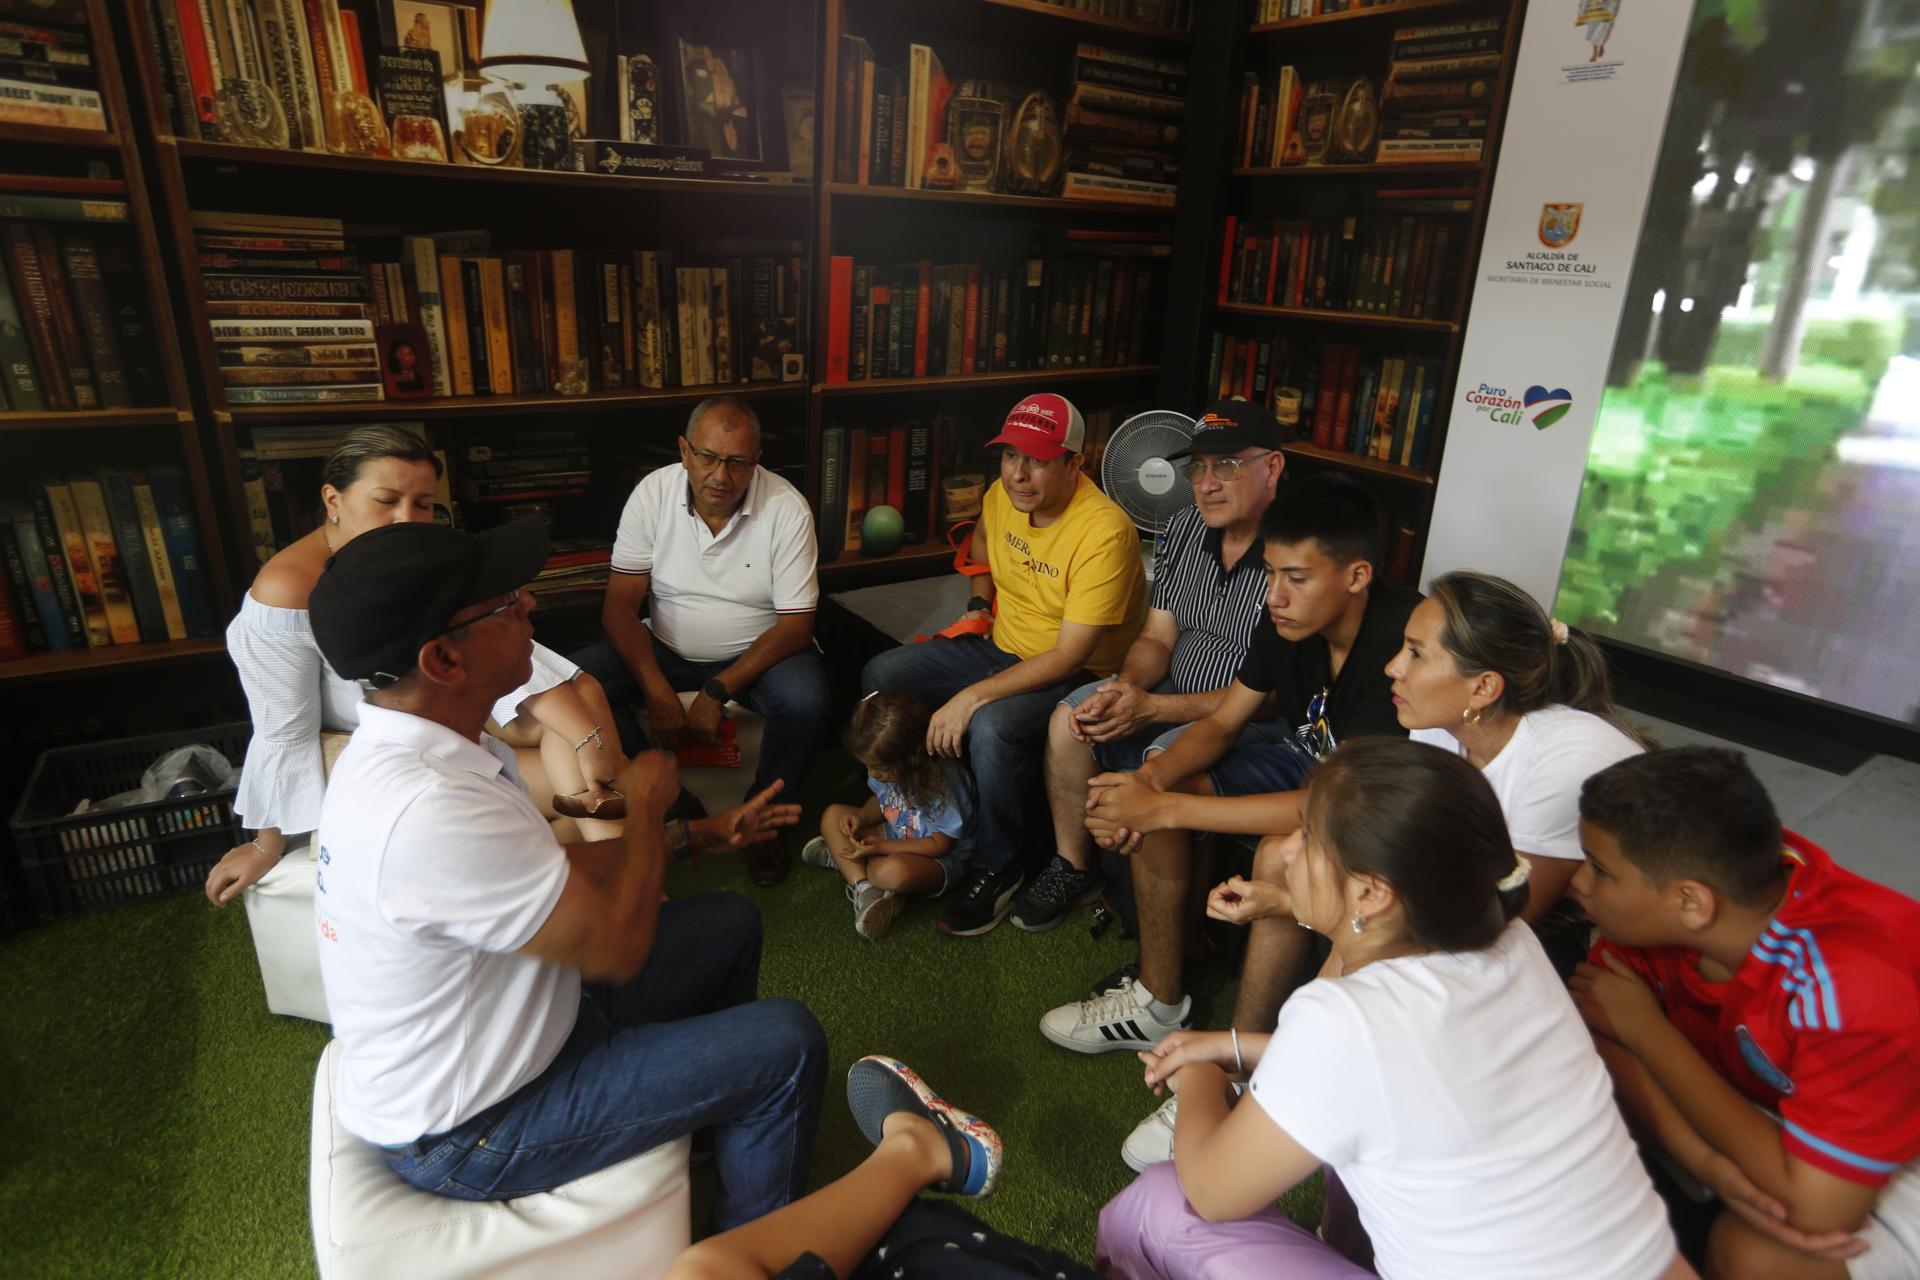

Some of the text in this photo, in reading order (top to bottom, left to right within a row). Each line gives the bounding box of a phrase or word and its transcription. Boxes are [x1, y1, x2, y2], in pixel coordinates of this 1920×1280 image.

[1526, 251, 1580, 261] ALCALDÍA DE
[1506, 261, 1597, 273] SANTIAGO DE CALI
[1530, 276, 1539, 285] DE
[1541, 276, 1582, 287] BIENESTAR
[1584, 278, 1612, 289] SOCIAL
[1478, 383, 1507, 396] Puro
[1466, 391, 1521, 409] Corazón
[1476, 405, 1523, 425] por Cali
